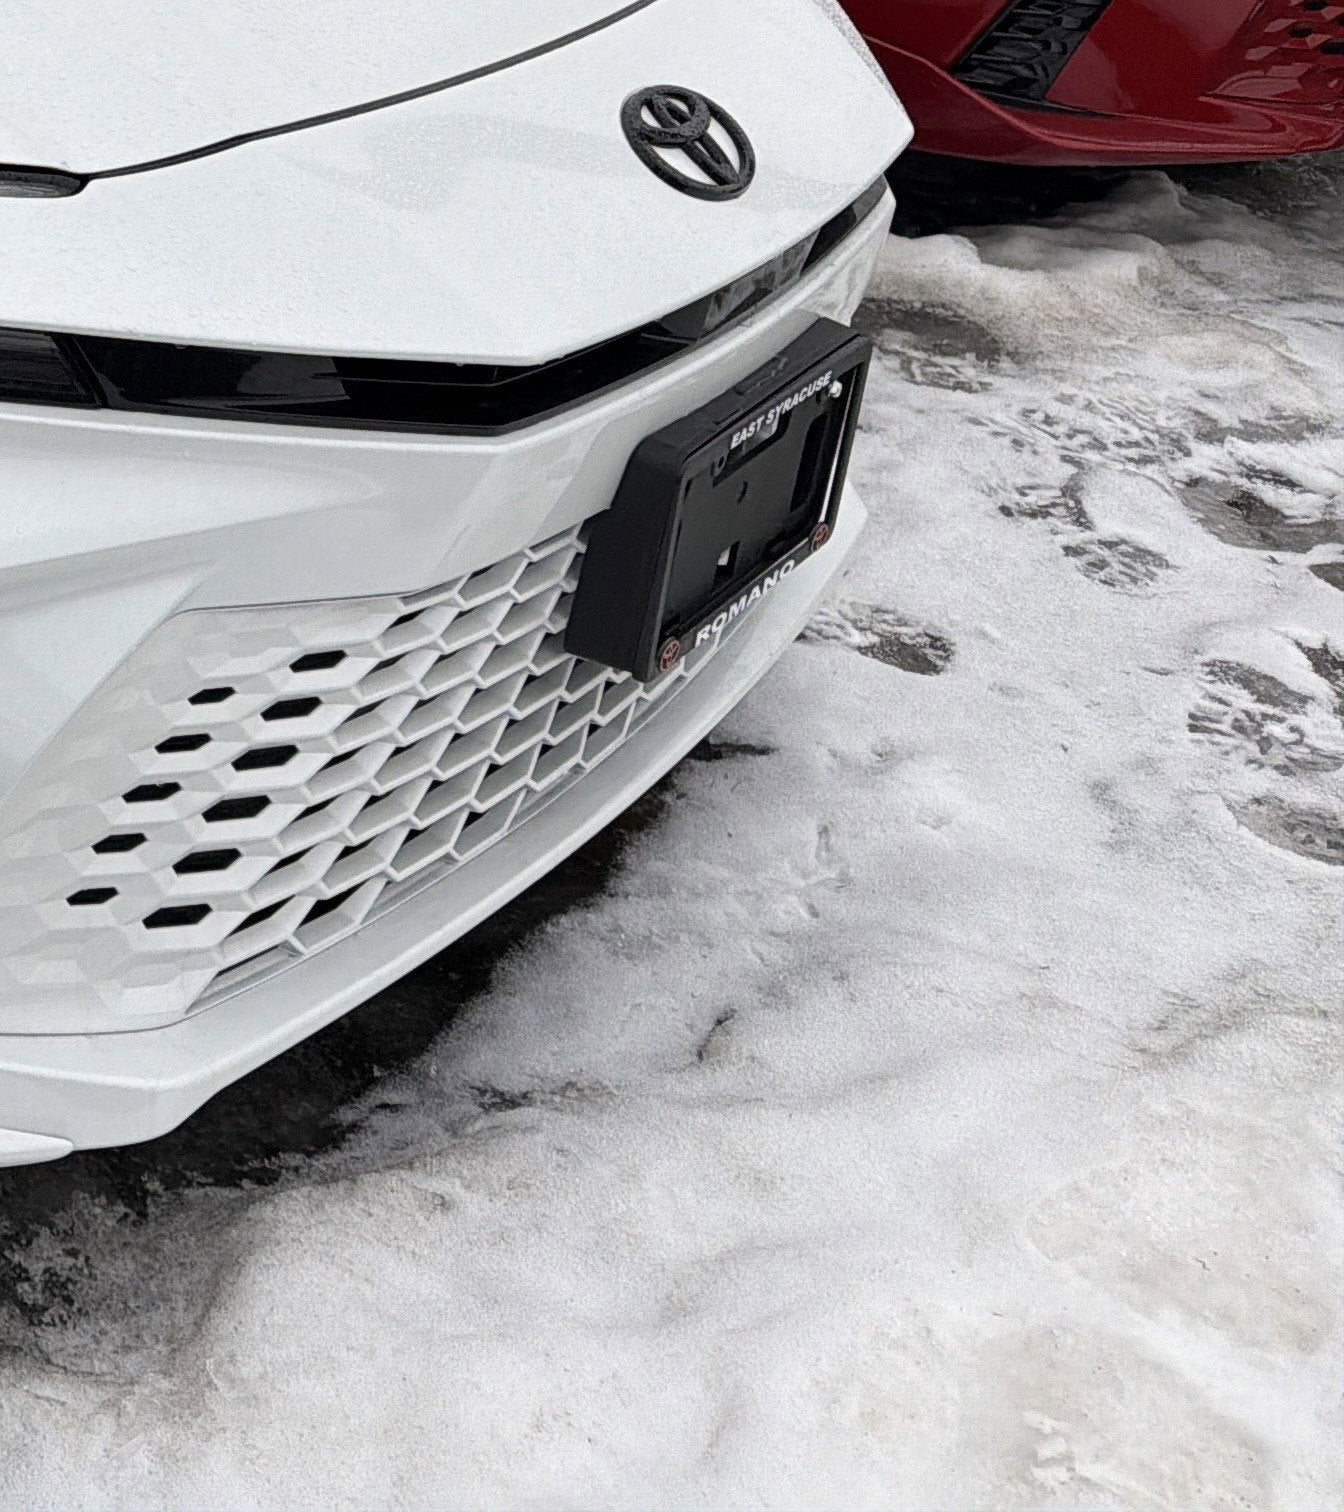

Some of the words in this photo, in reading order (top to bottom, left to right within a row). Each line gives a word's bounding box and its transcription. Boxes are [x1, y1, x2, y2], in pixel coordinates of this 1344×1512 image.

[730, 416, 763, 450] EAST
[765, 370, 833, 426] SYRACUSE
[694, 559, 795, 648] ROMANO
